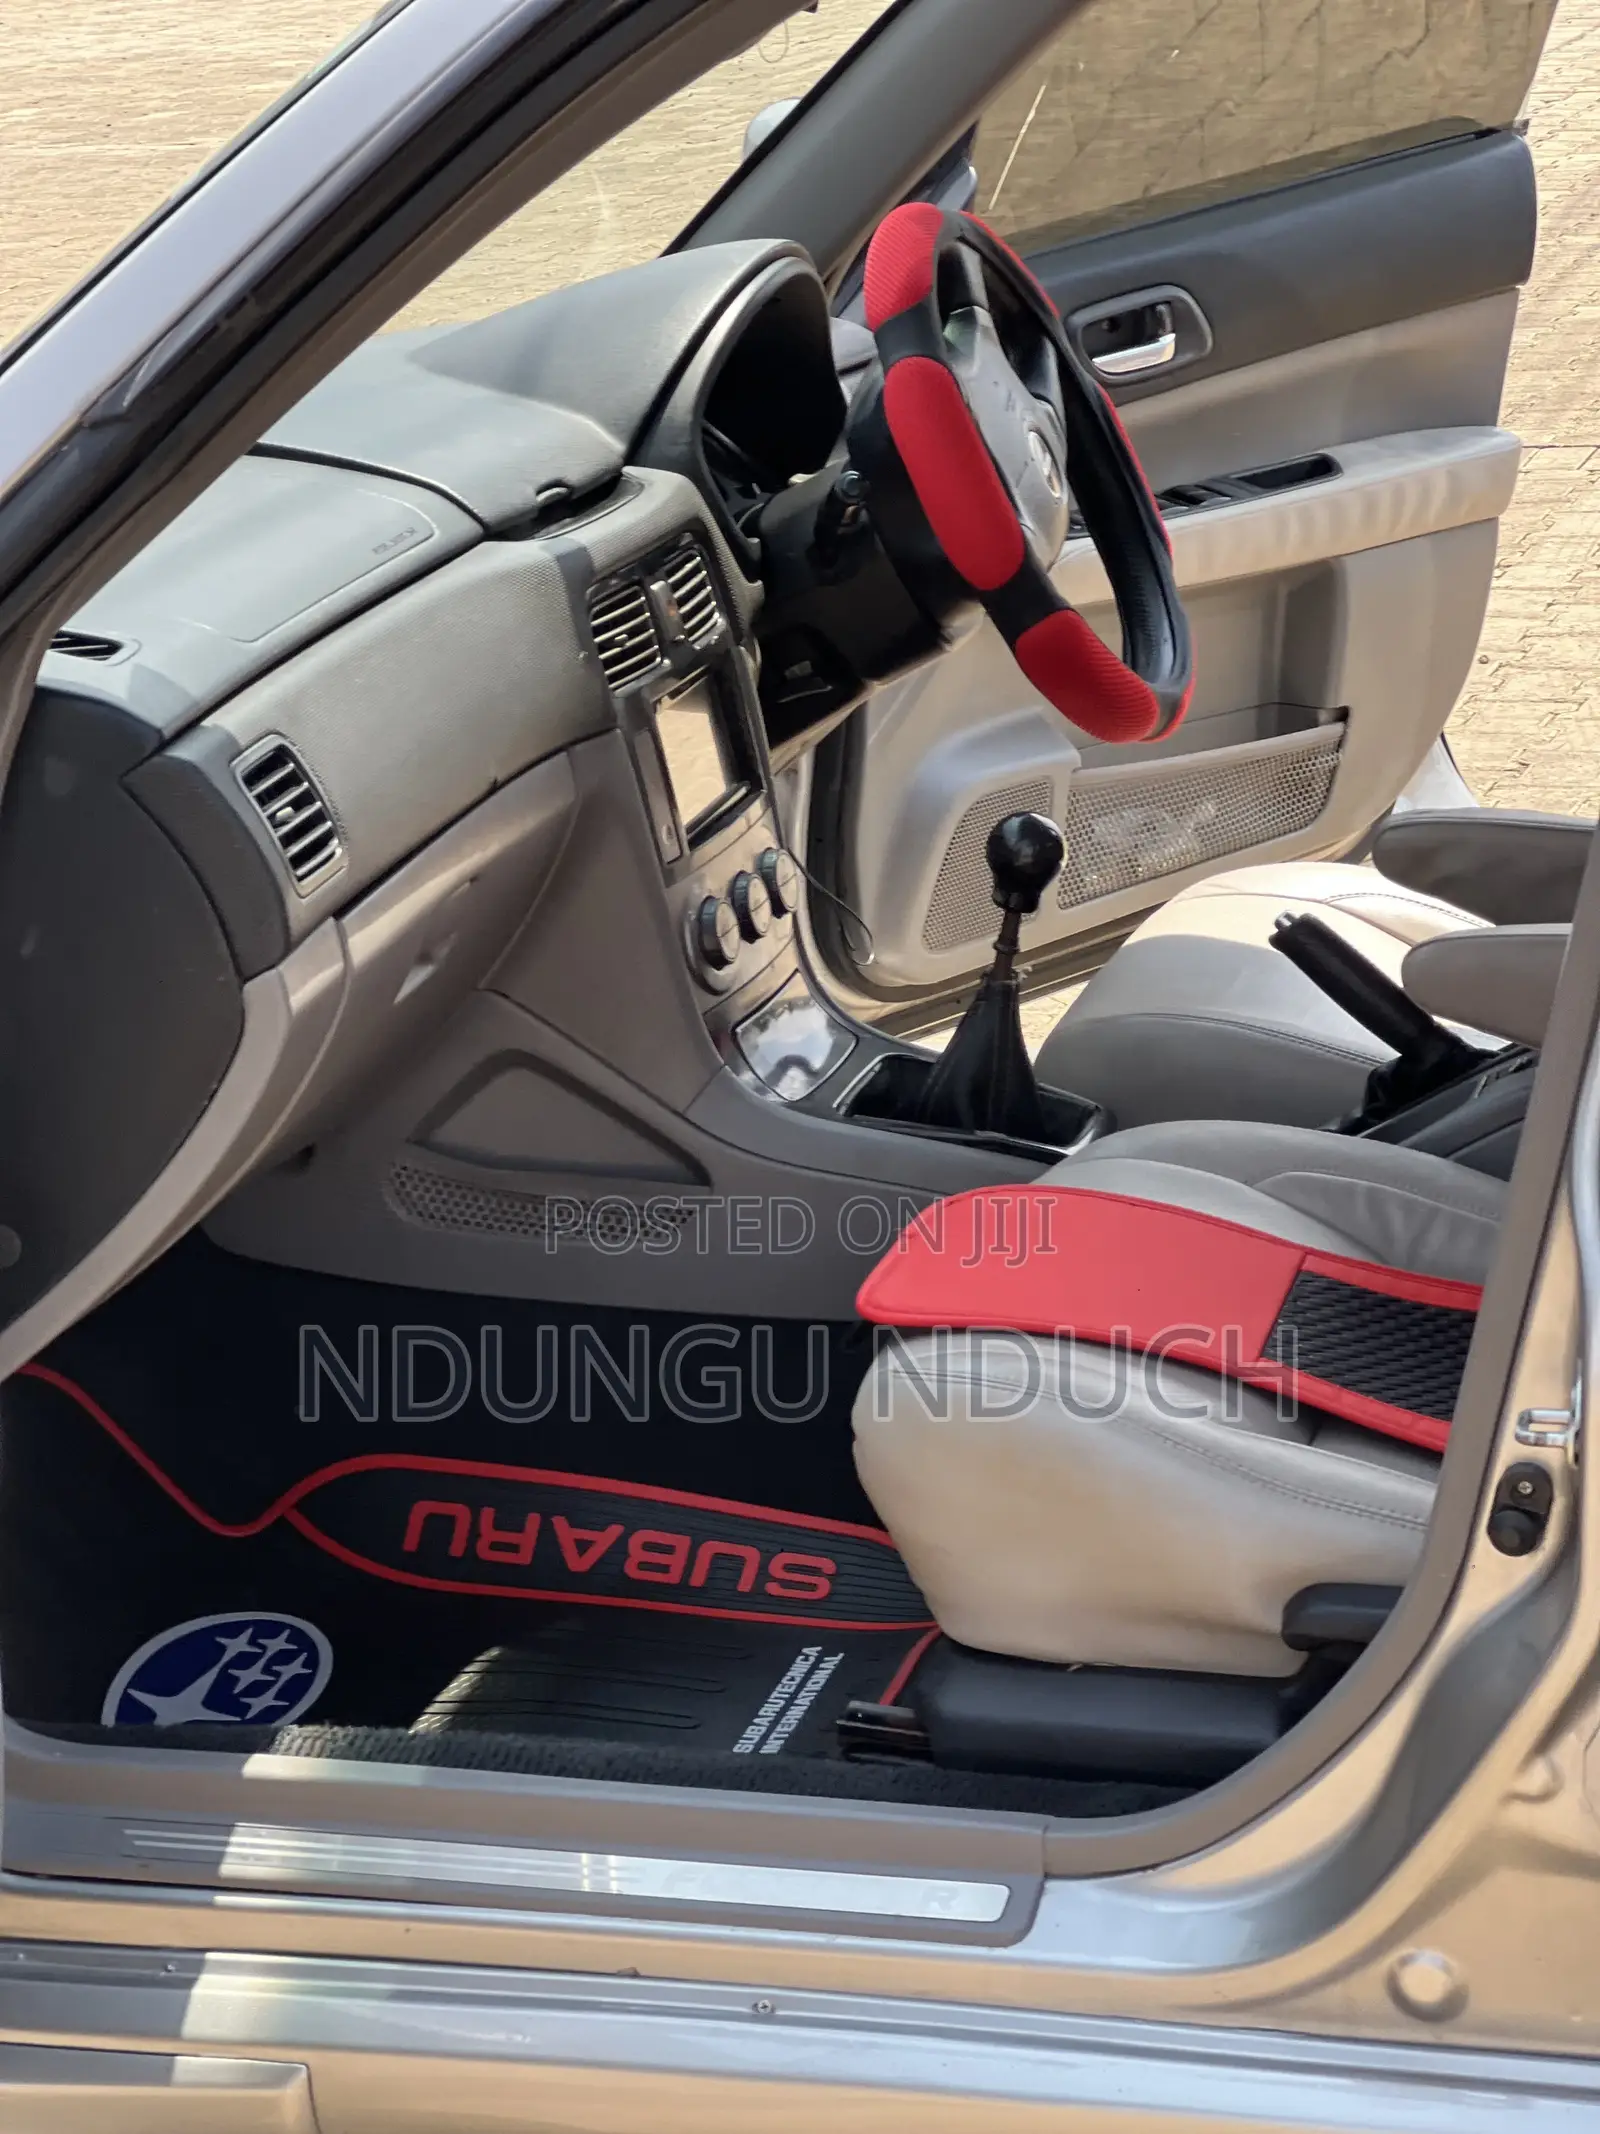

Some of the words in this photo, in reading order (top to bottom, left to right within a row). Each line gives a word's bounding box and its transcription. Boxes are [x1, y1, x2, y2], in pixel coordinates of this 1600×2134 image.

[402, 1500, 837, 1601] SUBARU
[732, 1646, 823, 1754] SUBARUTECNICA
[758, 1652, 845, 1754] INTERNATIONAL
